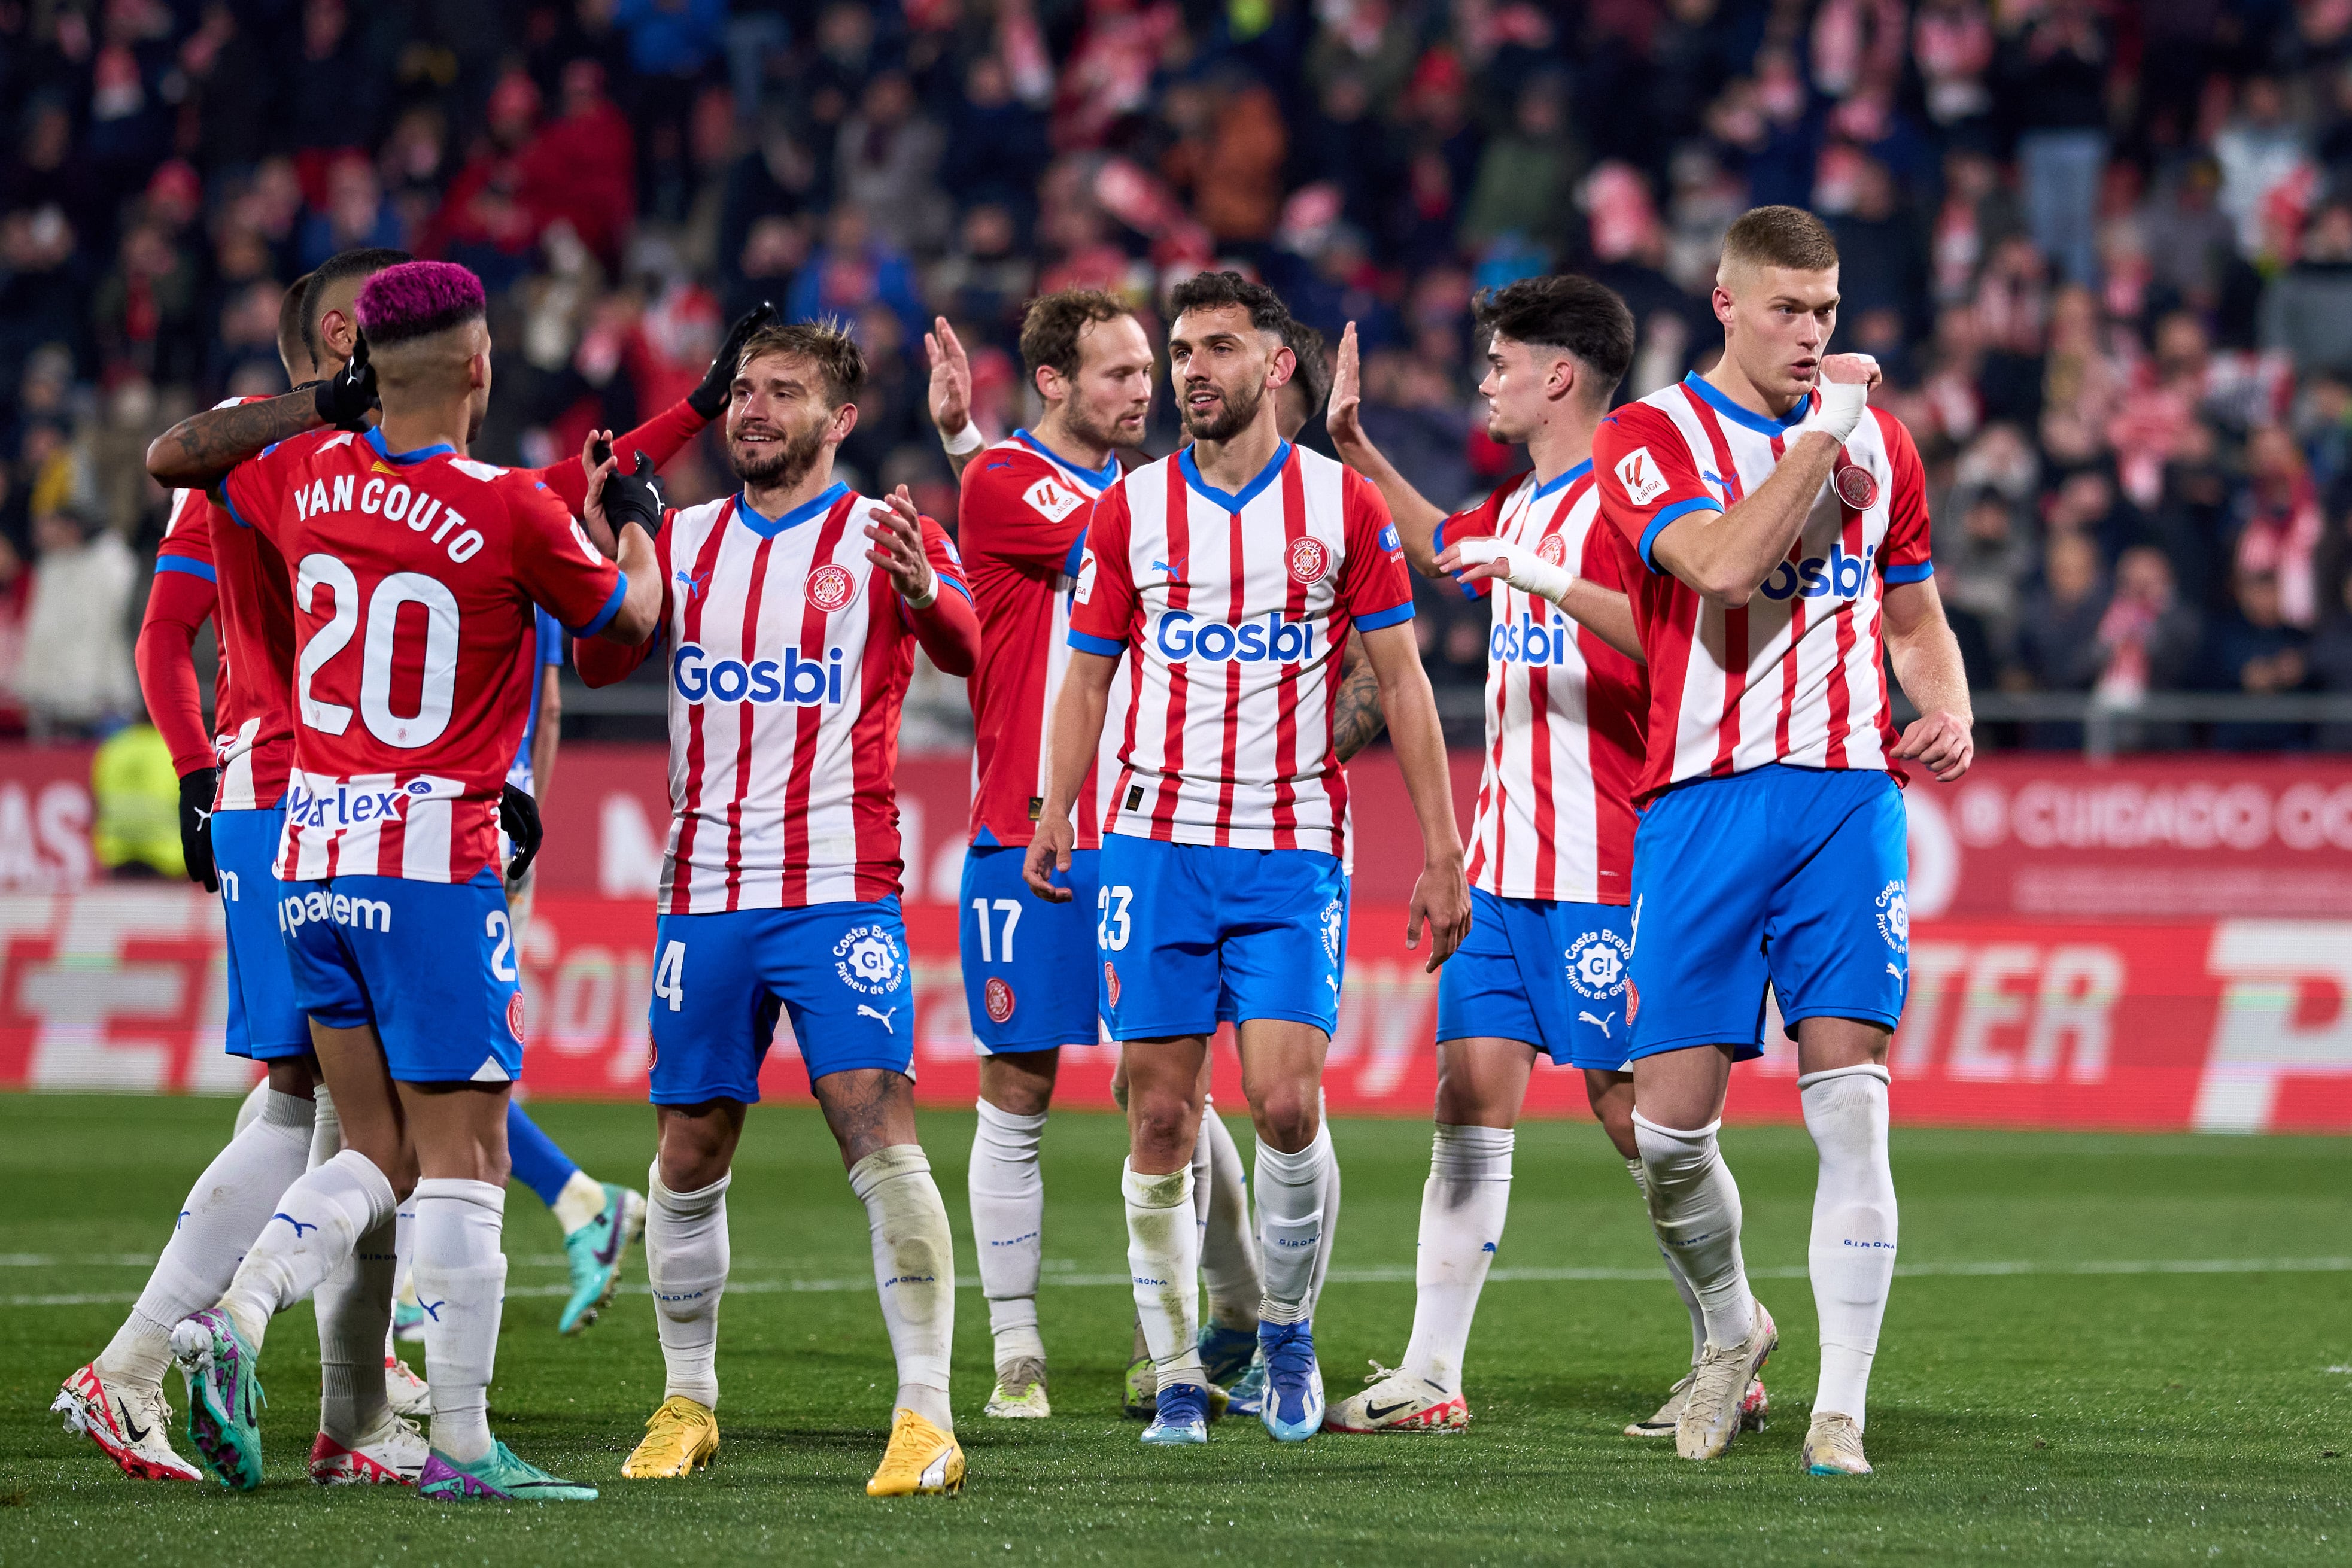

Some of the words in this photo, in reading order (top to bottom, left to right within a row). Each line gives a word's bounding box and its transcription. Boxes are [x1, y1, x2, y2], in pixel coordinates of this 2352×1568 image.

[1637, 481, 1661, 502] LALIGA
[294, 475, 355, 522] YAN
[361, 478, 484, 564] COUTO
[1293, 540, 1322, 552] GIRONA
[816, 569, 847, 580] GIRONA
[1761, 543, 1874, 600] osbi
[297, 553, 460, 749] 20
[1157, 611, 1314, 662] Gosbi
[1490, 613, 1564, 666] osbi
[674, 642, 843, 704] Gosbi
[1875, 880, 1900, 908] Costa
[973, 898, 1022, 963] 17
[1098, 886, 1134, 952] 23
[1876, 914, 1897, 950] Pirineu
[486, 910, 518, 982] 2
[832, 927, 868, 957] Costa
[871, 925, 900, 958] Brava
[1564, 932, 1598, 960] Costa
[1601, 929, 1631, 961] Brava
[655, 940, 686, 1011] 4
[835, 961, 867, 993] Pirineu
[870, 985, 885, 995] de
[886, 964, 904, 992] Girona
[862, 951, 885, 971] G!
[1590, 957, 1612, 977] G!
[1565, 965, 1592, 998] Pirineu
[1593, 990, 1607, 1000] de
[1844, 1239, 1895, 1250] GIRONA
